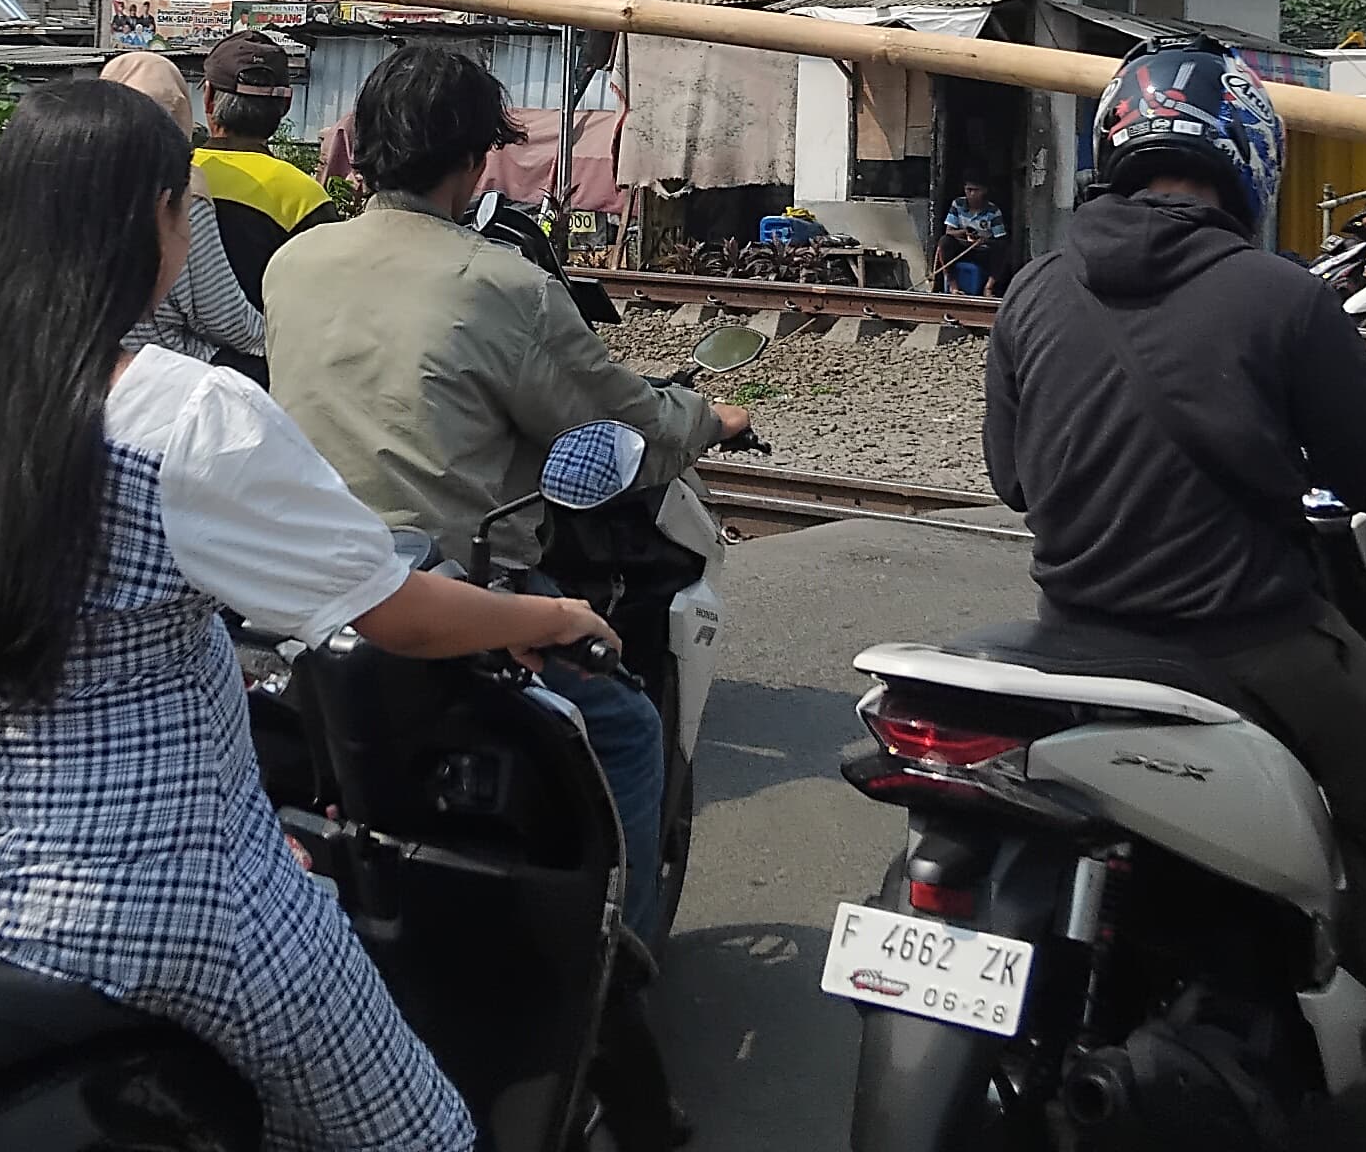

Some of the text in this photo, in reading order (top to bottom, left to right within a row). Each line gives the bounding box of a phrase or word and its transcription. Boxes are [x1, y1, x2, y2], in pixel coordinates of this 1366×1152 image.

[1110, 751, 1214, 782] PCX
[841, 914, 1023, 987] F 4662 ZK
